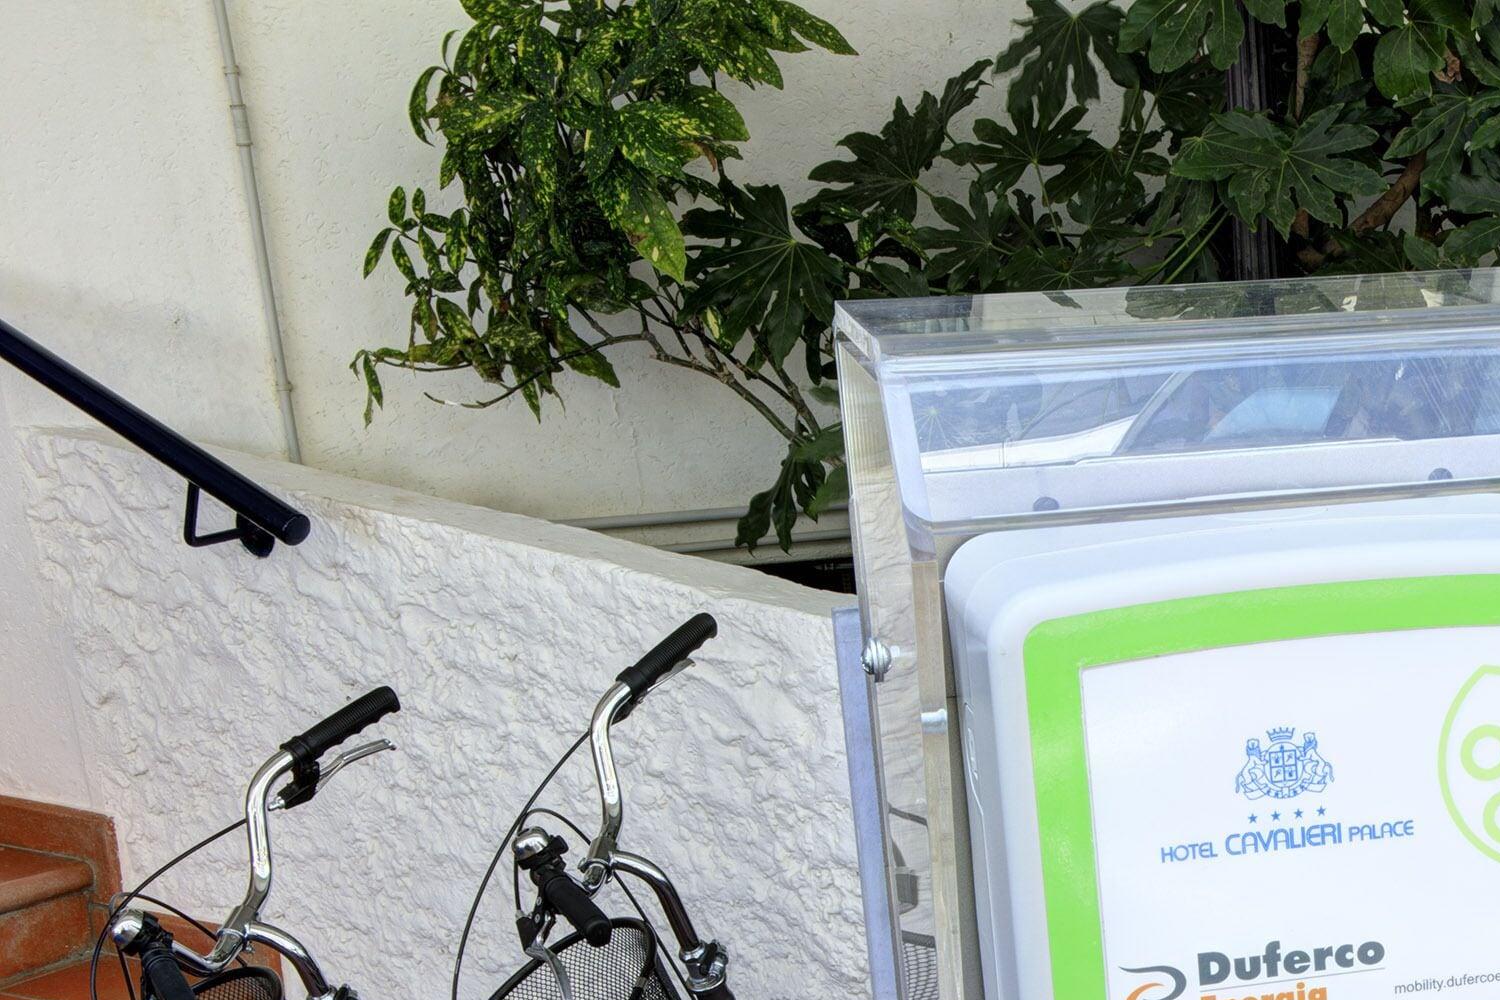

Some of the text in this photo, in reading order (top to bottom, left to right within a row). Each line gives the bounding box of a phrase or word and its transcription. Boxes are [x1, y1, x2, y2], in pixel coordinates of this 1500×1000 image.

[1160, 819, 1415, 863] HOTEL CAVALIERI PALACE
[1197, 940, 1386, 986] Duferco
